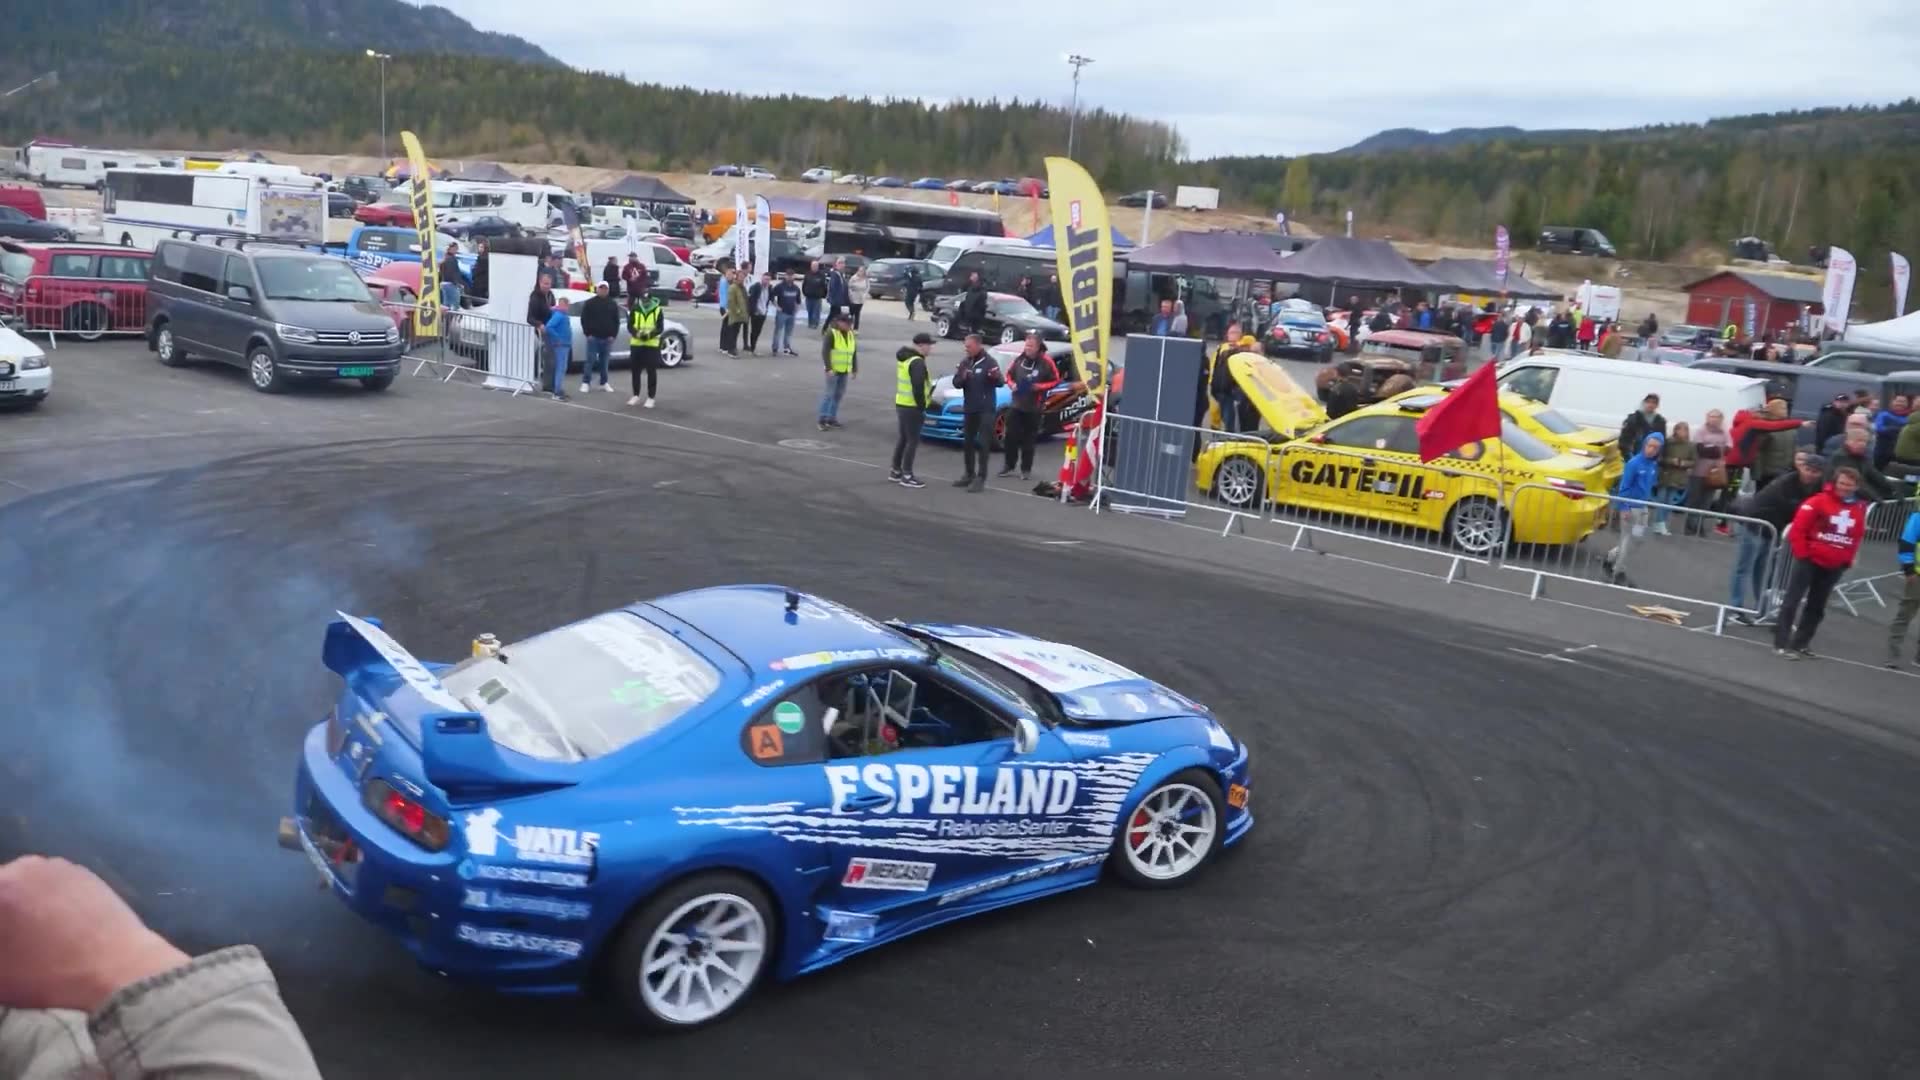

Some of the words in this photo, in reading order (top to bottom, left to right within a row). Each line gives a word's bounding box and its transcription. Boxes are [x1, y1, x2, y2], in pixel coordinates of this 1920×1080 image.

[759, 730, 779, 754] A
[824, 763, 1078, 816] ESPELAND
[938, 818, 1073, 838] RekvisitaSenter
